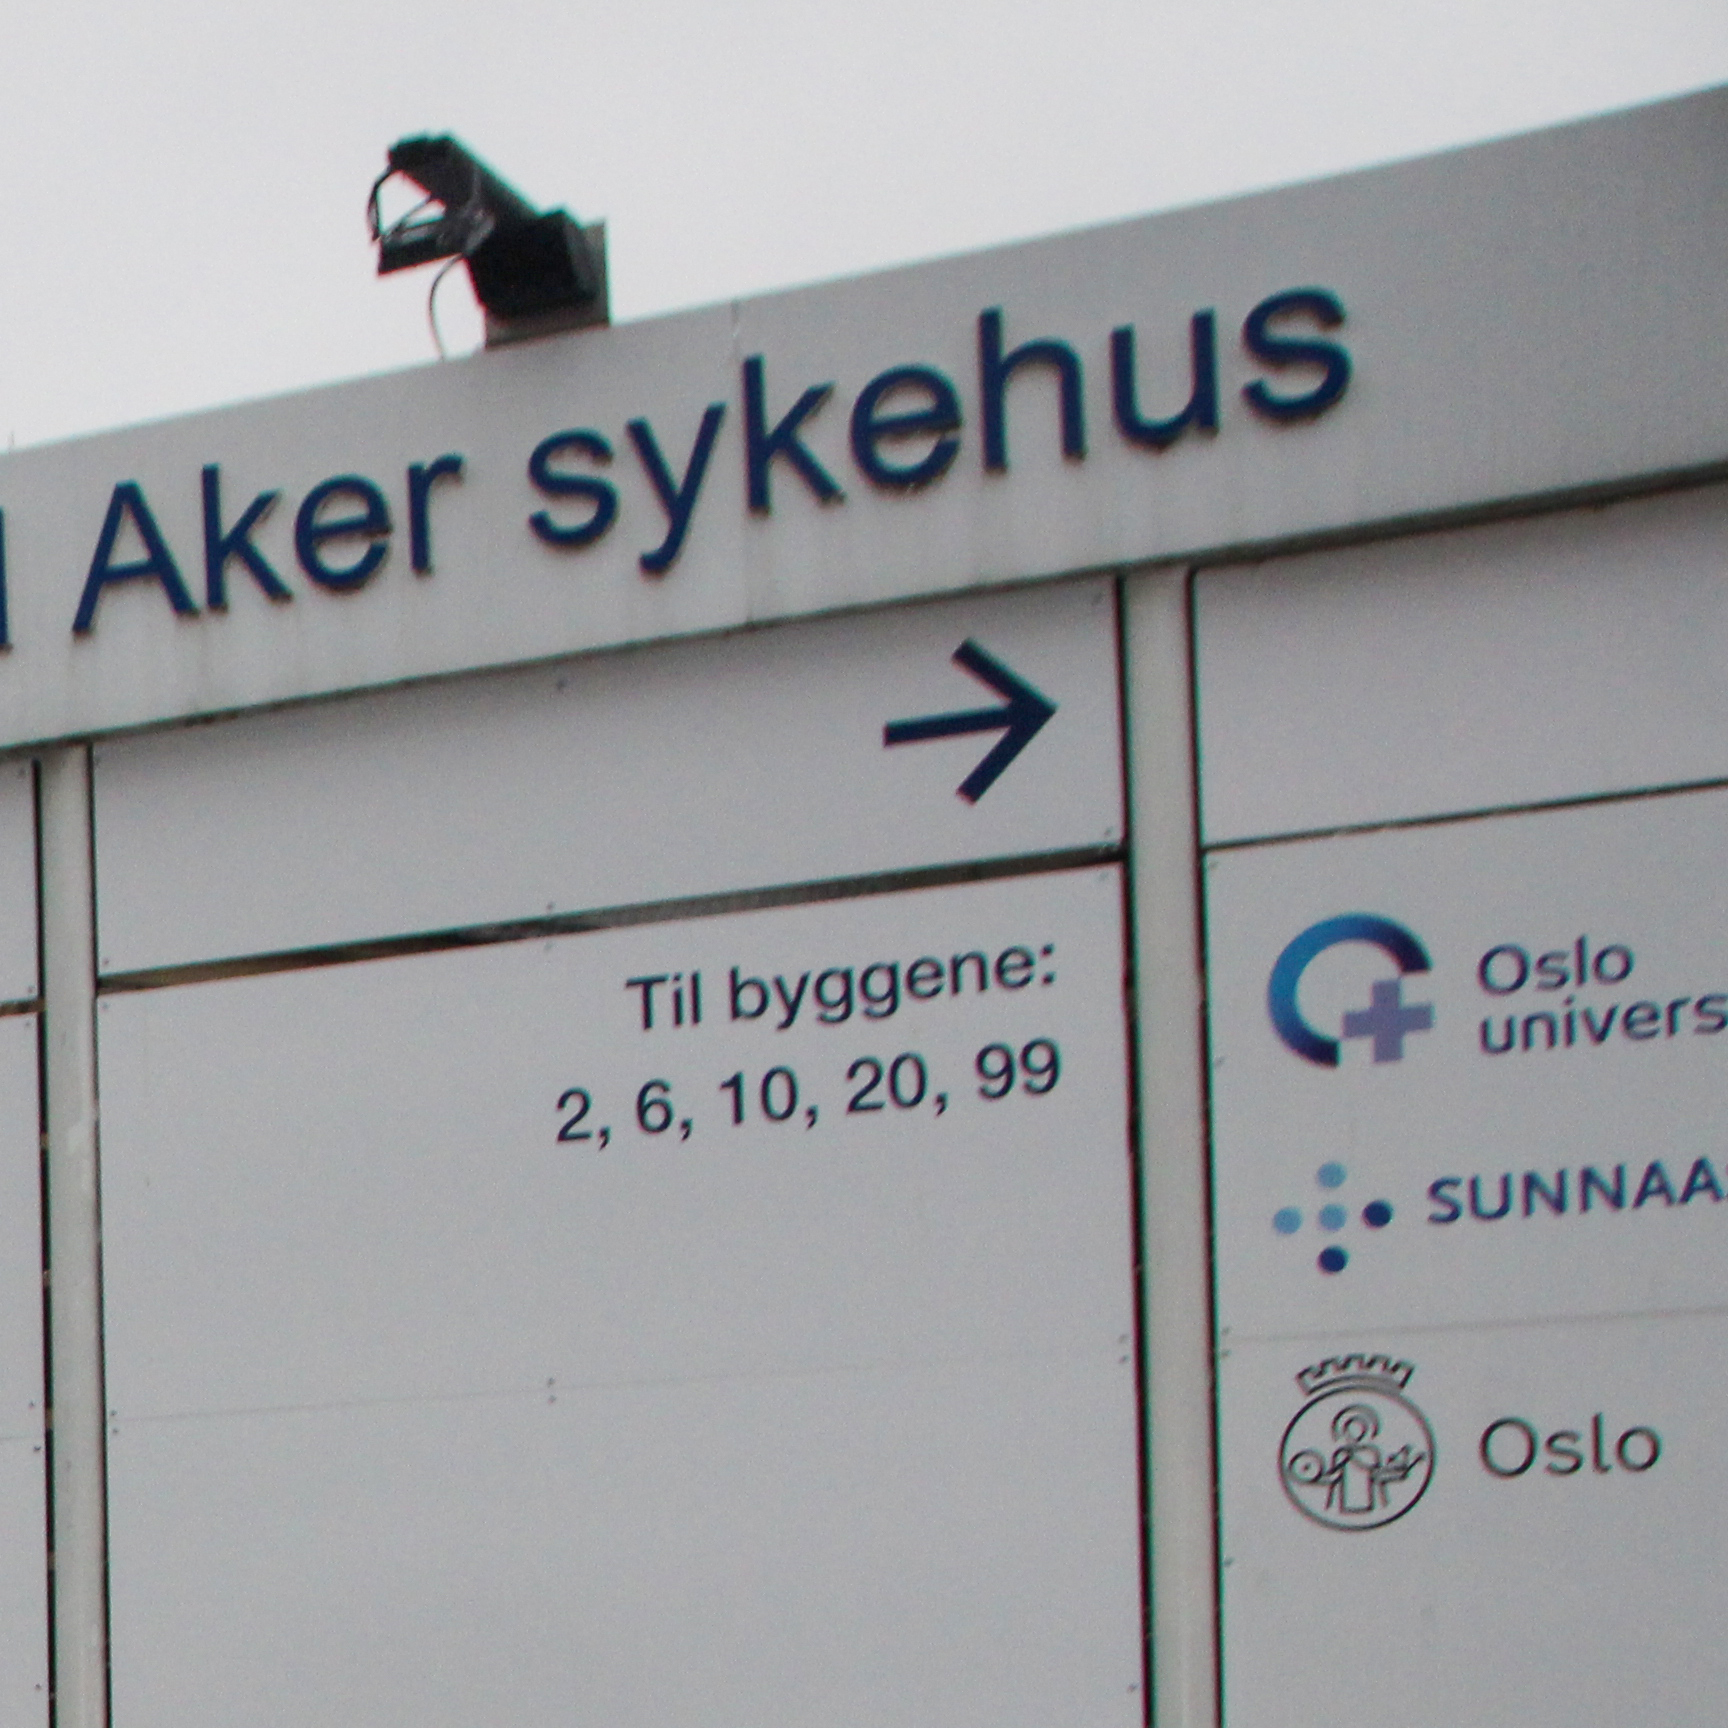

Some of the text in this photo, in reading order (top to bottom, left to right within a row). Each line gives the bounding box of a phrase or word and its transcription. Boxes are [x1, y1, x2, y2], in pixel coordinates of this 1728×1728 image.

[71, 454, 465, 643] Aker
[527, 286, 1356, 576] sykehus
[625, 942, 1056, 1031] Til byggene:
[1477, 935, 1635, 997] Oslo
[1478, 992, 1728, 1056] univers
[556, 1038, 1062, 1150] 2, 6, 10, 20, 99
[1427, 1156, 1728, 1225] SUNNAA
[1478, 1412, 1662, 1479] Oslo
